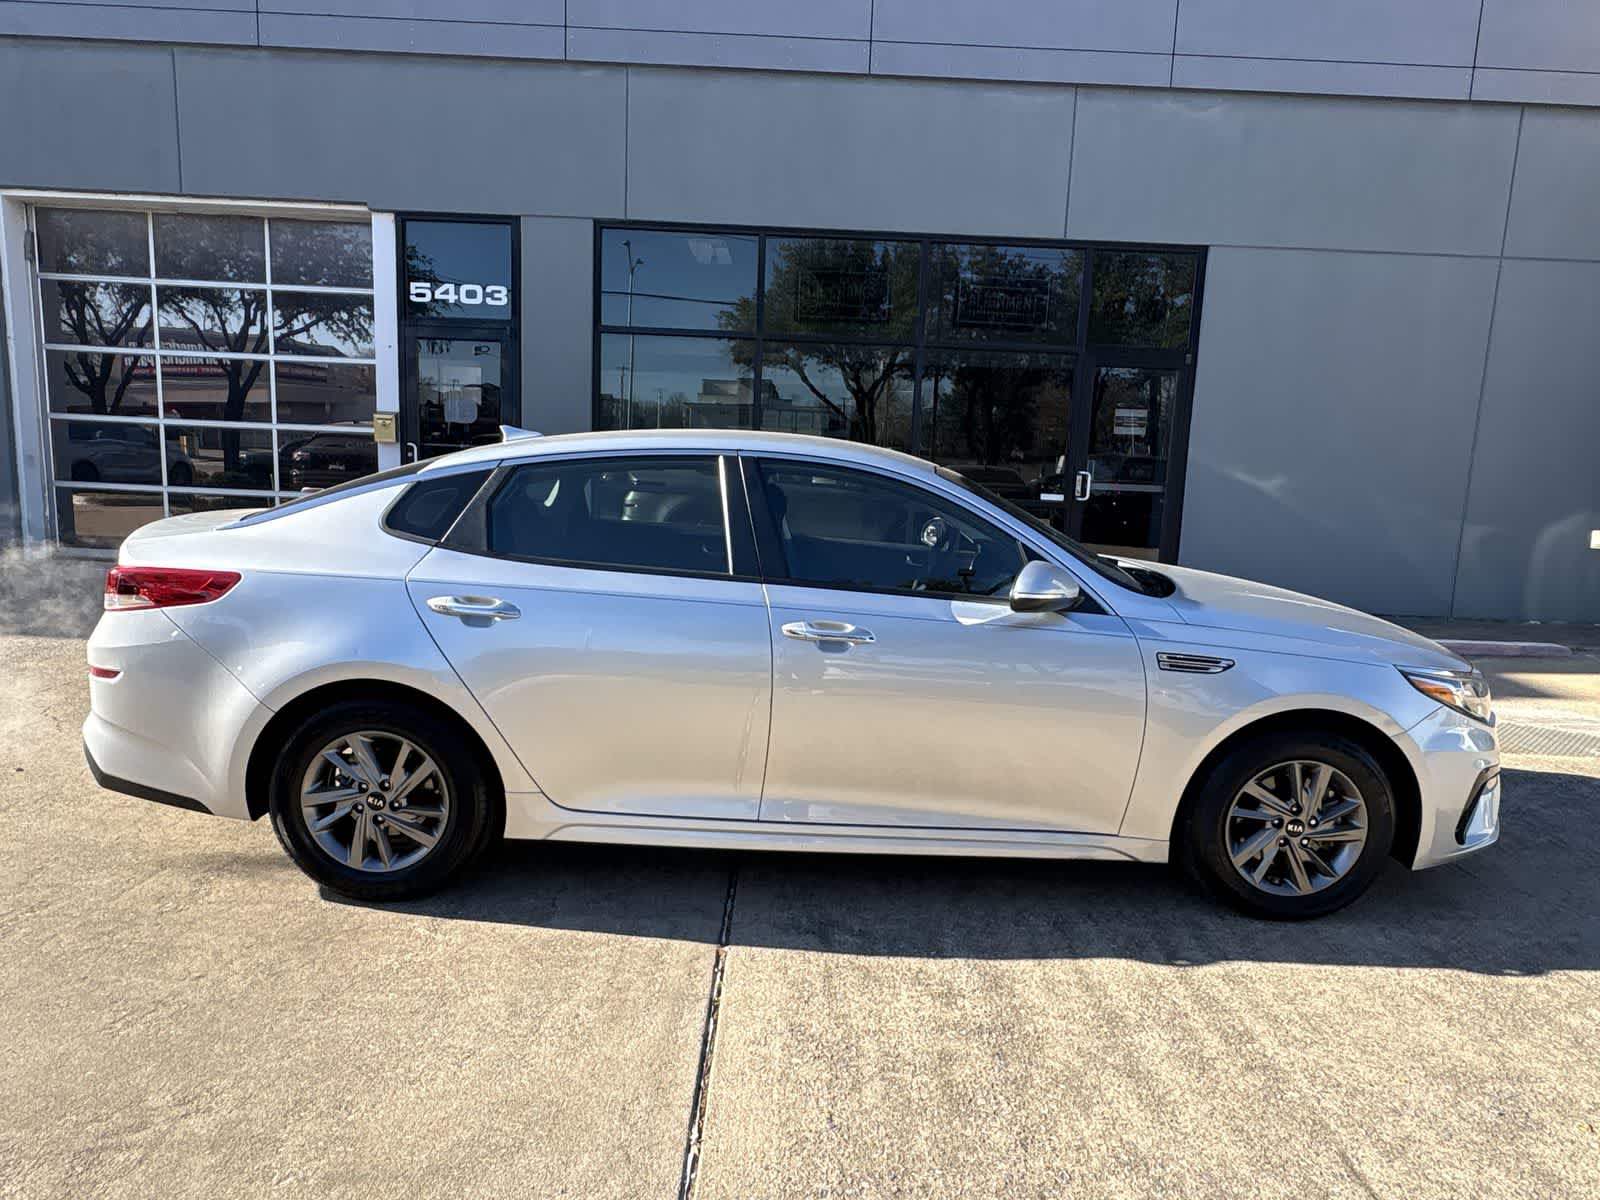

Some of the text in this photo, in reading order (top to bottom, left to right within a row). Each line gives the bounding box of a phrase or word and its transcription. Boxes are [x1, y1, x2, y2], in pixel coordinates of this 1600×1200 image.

[409, 281, 508, 307] 5403
[367, 796, 384, 808] KIA
[1287, 824, 1303, 833] KIA
